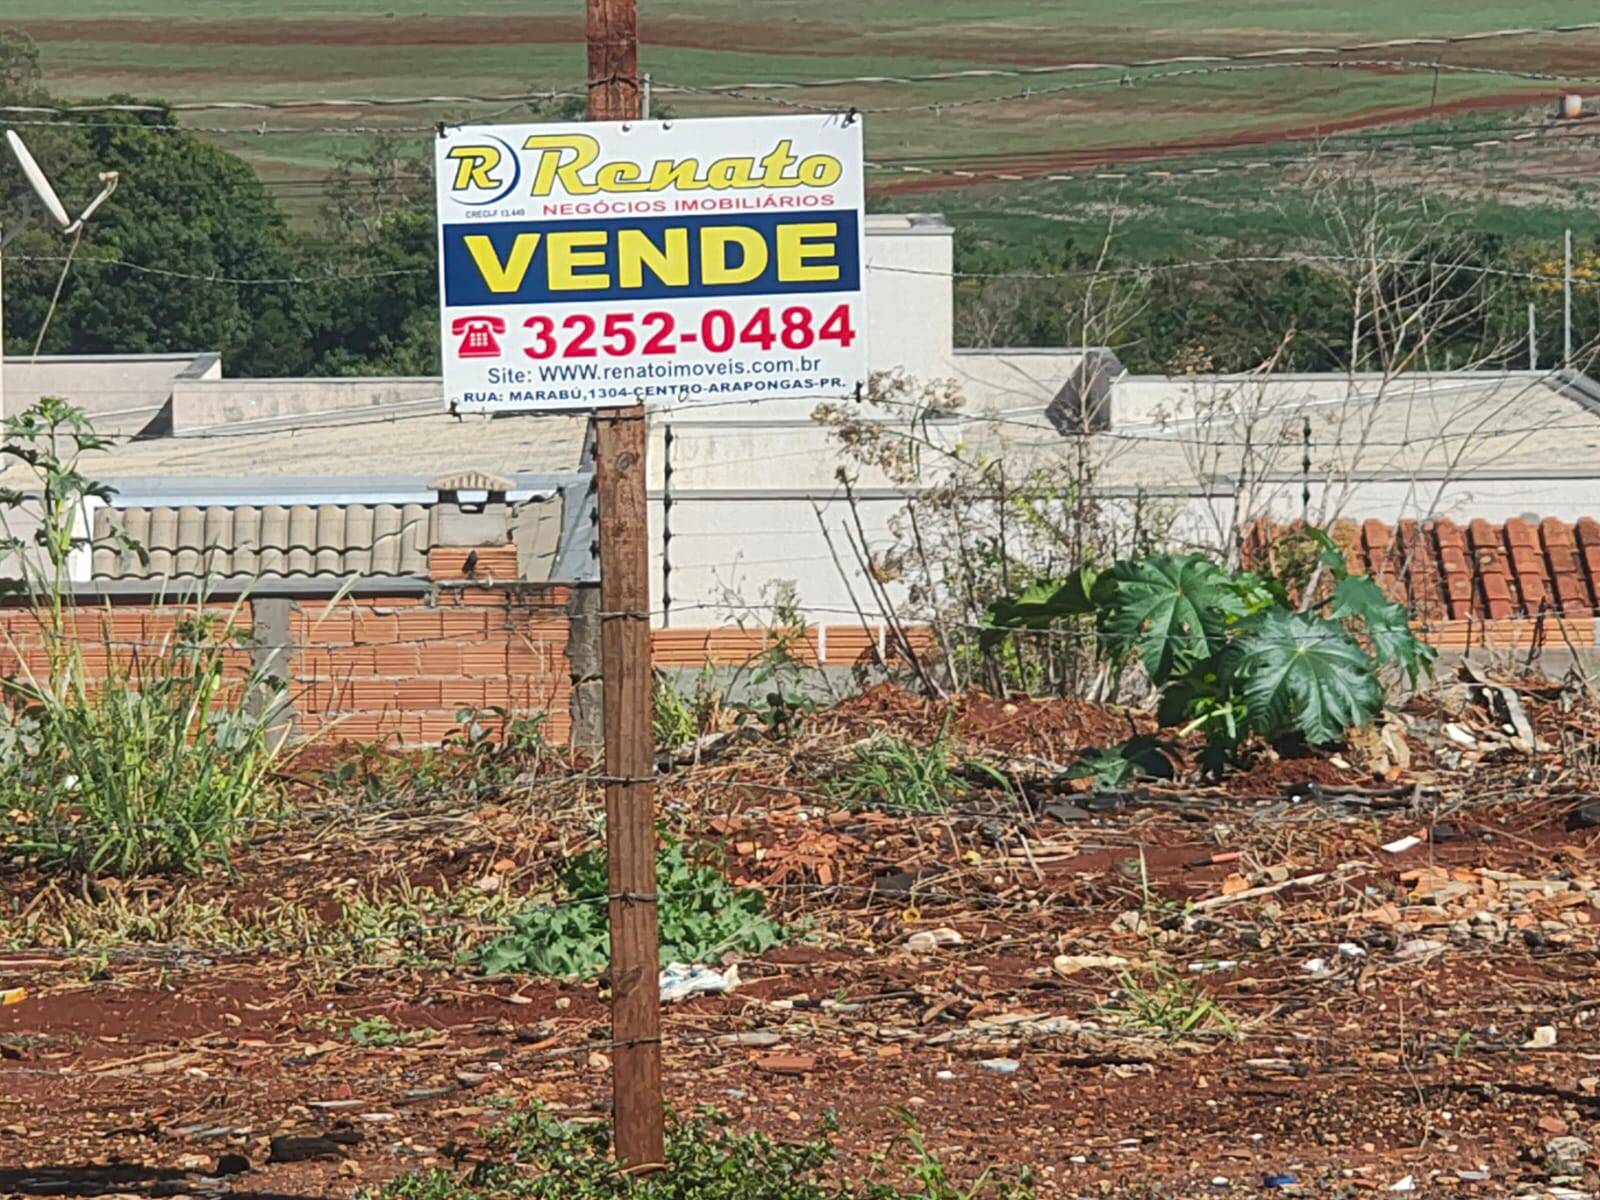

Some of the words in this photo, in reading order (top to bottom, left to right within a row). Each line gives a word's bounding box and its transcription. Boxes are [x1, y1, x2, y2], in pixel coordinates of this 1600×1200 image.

[446, 145, 503, 191] R
[522, 133, 843, 197] Renato
[543, 200, 668, 216] NEGÓCIOS
[674, 194, 835, 213] IMOBILIÁRIOS
[463, 222, 840, 293] VENDE
[523, 304, 856, 360] 3252-0484
[487, 367, 533, 384] Site:
[538, 355, 821, 382] WWW.renatoimoveis.com.br
[463, 392, 504, 402] RUA:
